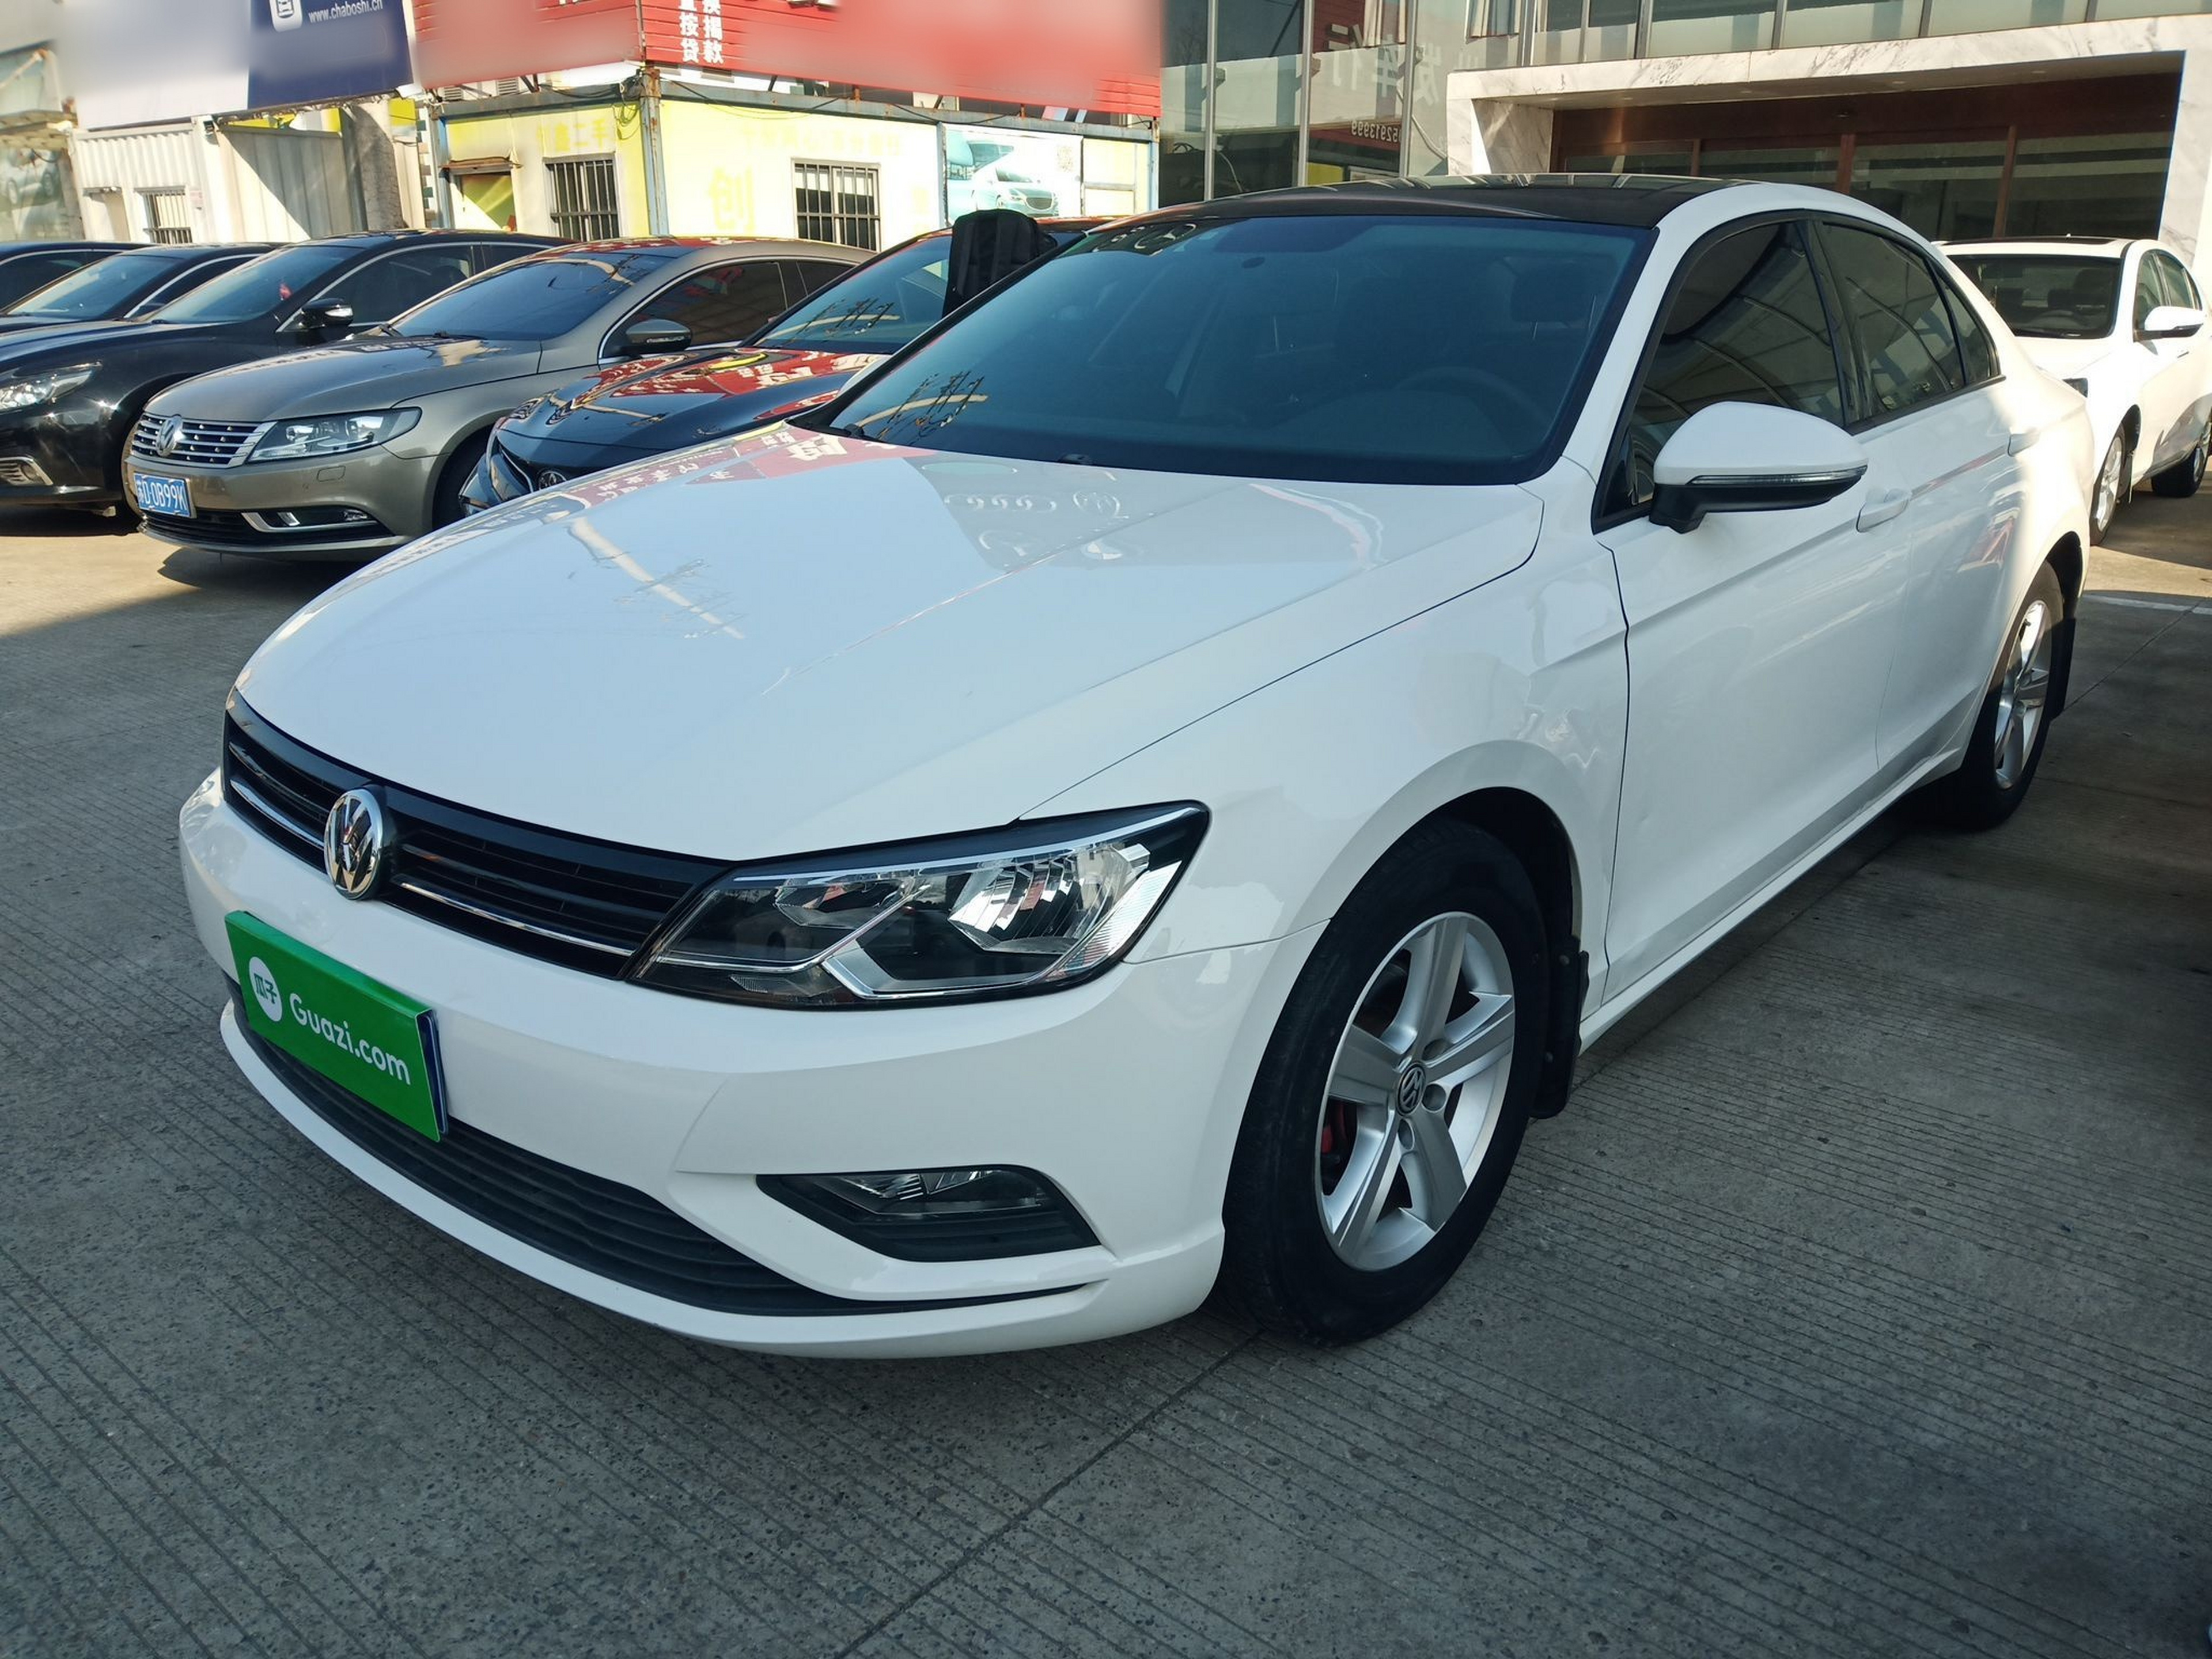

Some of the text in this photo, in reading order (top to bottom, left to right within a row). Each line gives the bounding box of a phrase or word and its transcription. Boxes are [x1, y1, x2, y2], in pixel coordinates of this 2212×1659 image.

[308, 0, 384, 23] www.chaboshi.cn
[253, 973, 277, 1005] 瓜子
[289, 993, 411, 1085] Guazi.com
